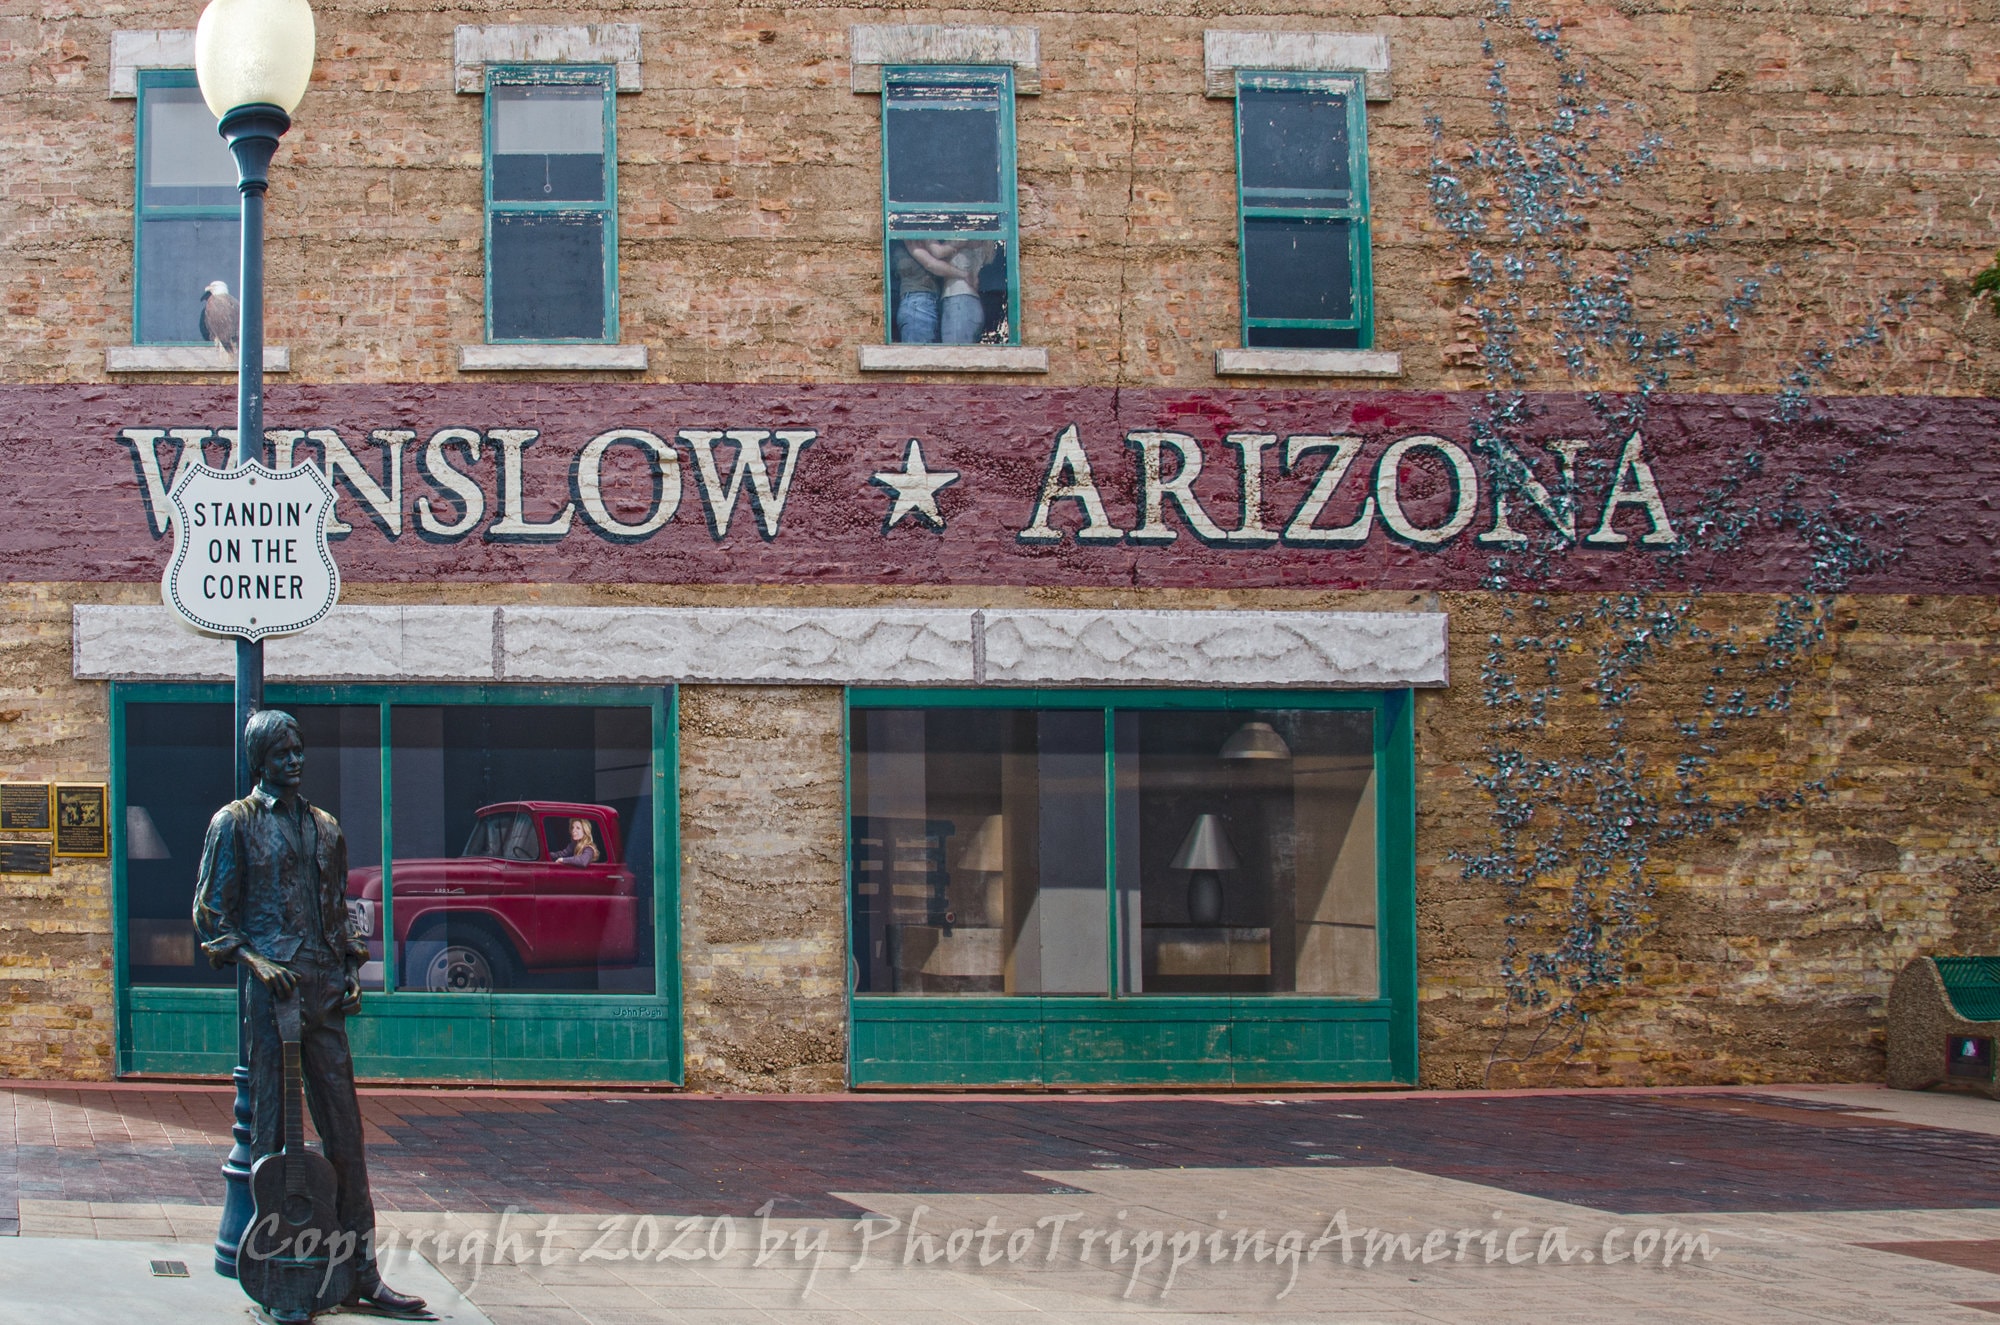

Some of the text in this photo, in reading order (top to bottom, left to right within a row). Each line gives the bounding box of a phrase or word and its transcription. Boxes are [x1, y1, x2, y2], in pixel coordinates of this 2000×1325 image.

[1018, 422, 1679, 545] ARIZONA
[194, 502, 312, 526] STANDIN'
[209, 538, 297, 563] ON THE
[203, 574, 303, 599] CORNER
[613, 1006, 662, 1018] John Pugh
